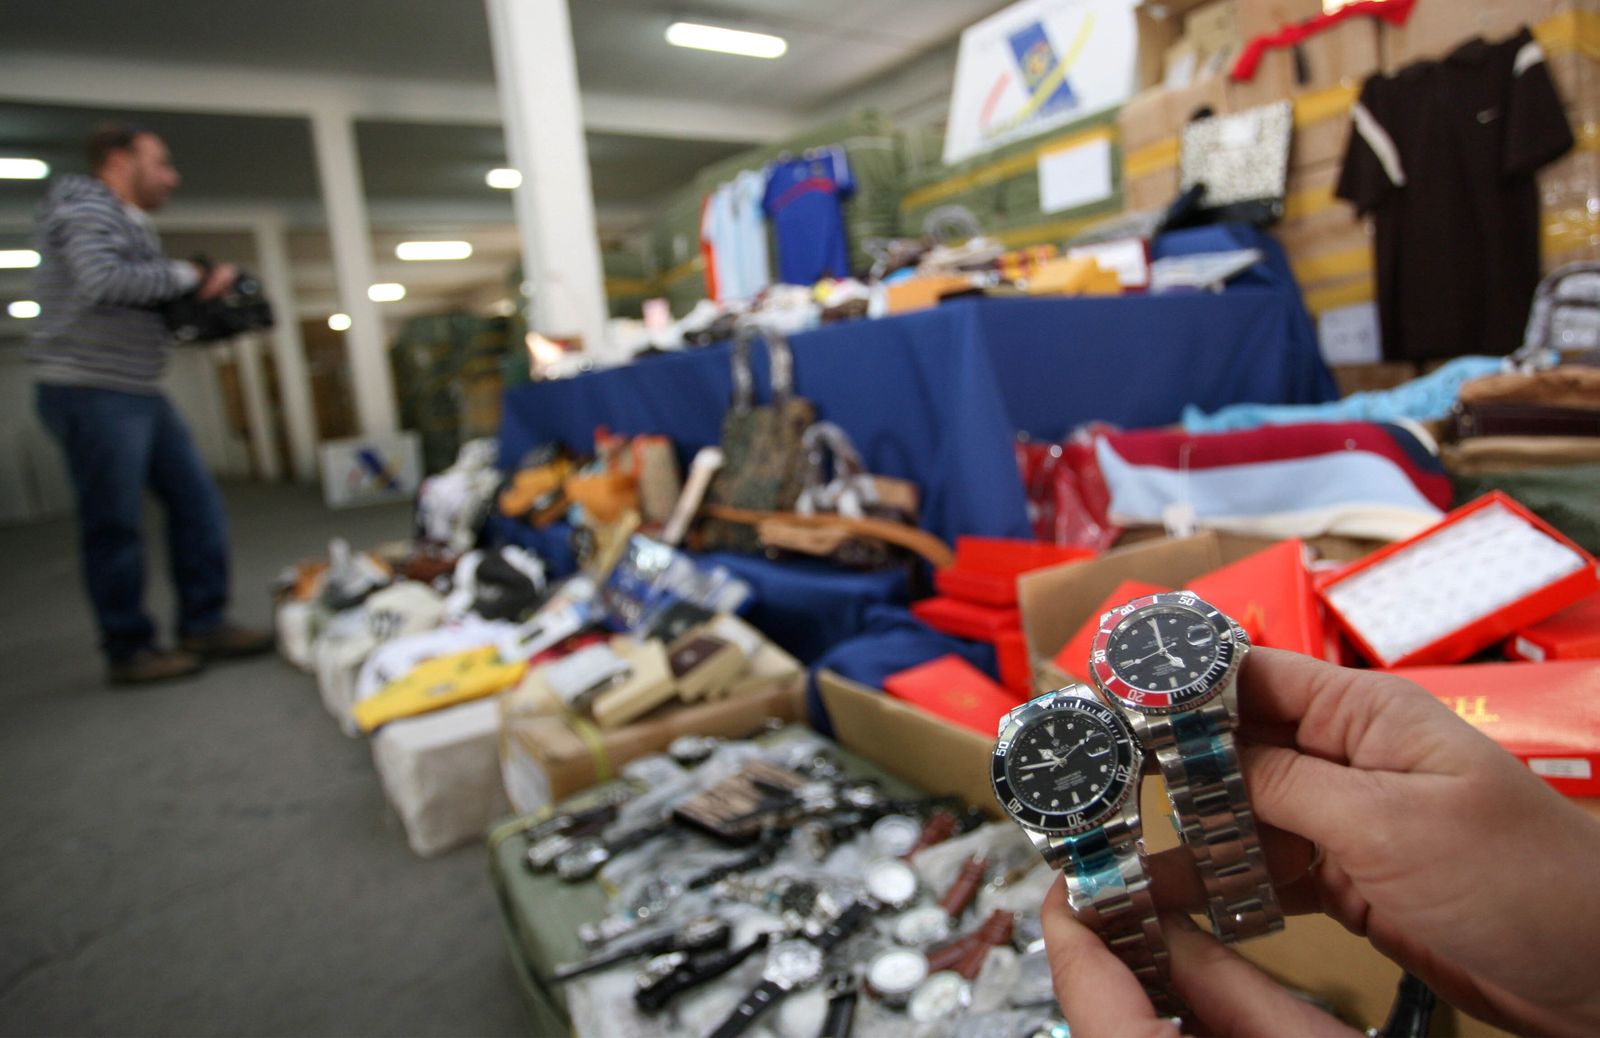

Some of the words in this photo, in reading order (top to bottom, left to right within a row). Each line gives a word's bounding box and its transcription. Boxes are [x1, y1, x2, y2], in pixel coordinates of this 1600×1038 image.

[1178, 596, 1196, 606] 50
[1120, 604, 1135, 616] 40
[1094, 649, 1106, 664] 30
[1127, 689, 1146, 703] 20
[1097, 709, 1112, 724] 10
[996, 741, 1009, 757] 50
[1115, 764, 1131, 783] 20
[1007, 798, 1024, 814] 40
[1067, 811, 1087, 828] 30
